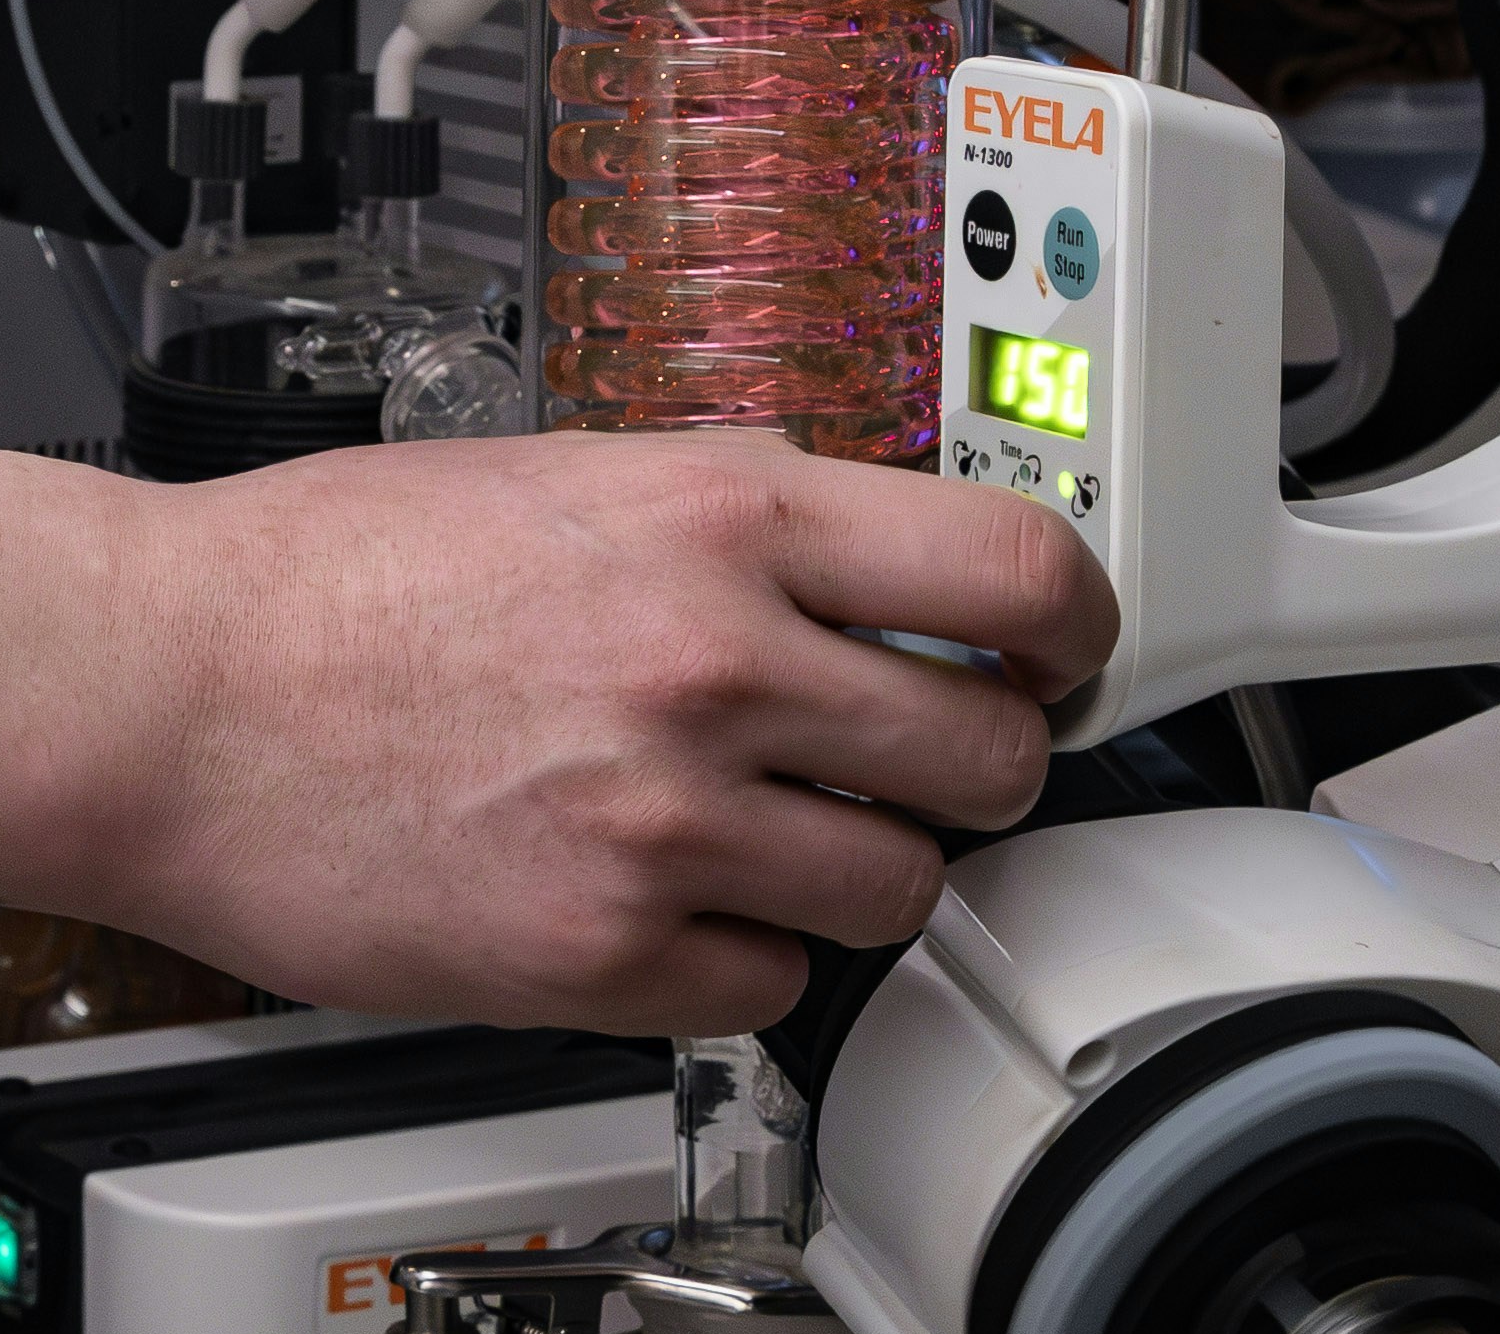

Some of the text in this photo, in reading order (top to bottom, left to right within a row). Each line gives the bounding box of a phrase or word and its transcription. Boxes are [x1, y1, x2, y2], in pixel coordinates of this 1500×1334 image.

[963, 85, 1104, 156] EYELA
[963, 143, 1013, 169] N-1300
[967, 220, 1010, 251] Power
[1056, 219, 1084, 248] Run
[1054, 253, 1085, 285] Stop
[1000, 439, 1023, 460] Time
